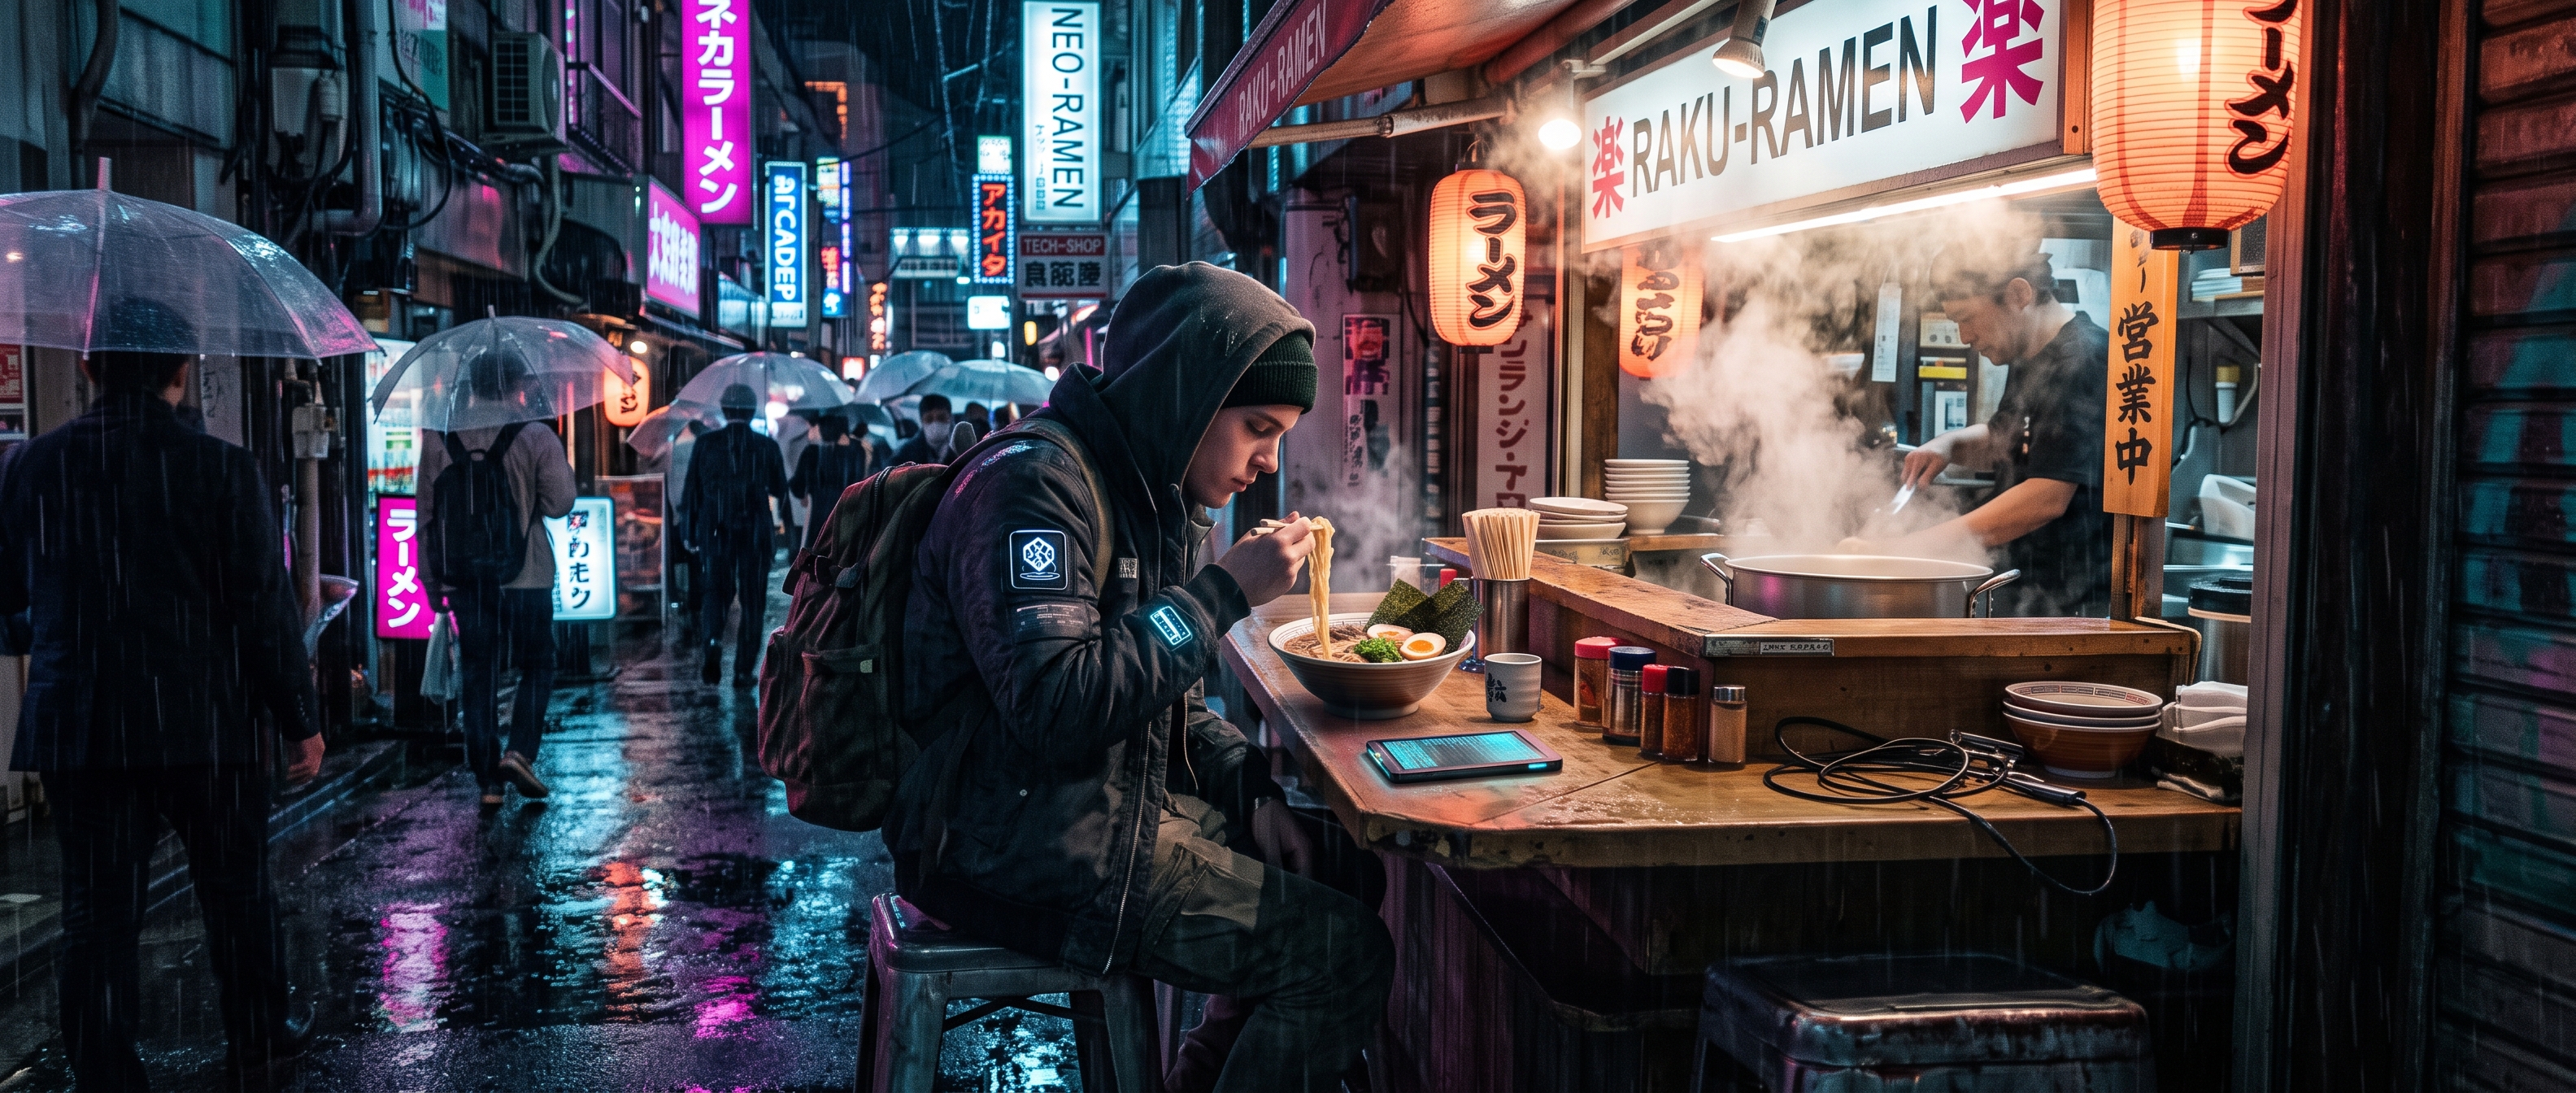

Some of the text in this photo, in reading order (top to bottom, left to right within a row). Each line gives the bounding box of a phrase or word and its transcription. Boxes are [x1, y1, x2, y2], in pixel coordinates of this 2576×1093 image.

[1051, 7, 1085, 207] NEO-RAMEN
[1238, 0, 1327, 142] RAKU-RAMEN
[1592, 0, 2045, 220] 楽 RAKU-RAMEN 楽
[981, 184, 1007, 277] アカイタ
[1024, 238, 1102, 254] TECH-SHOP
[1468, 190, 1518, 329] ラーメン
[386, 508, 421, 629] ラーメン
